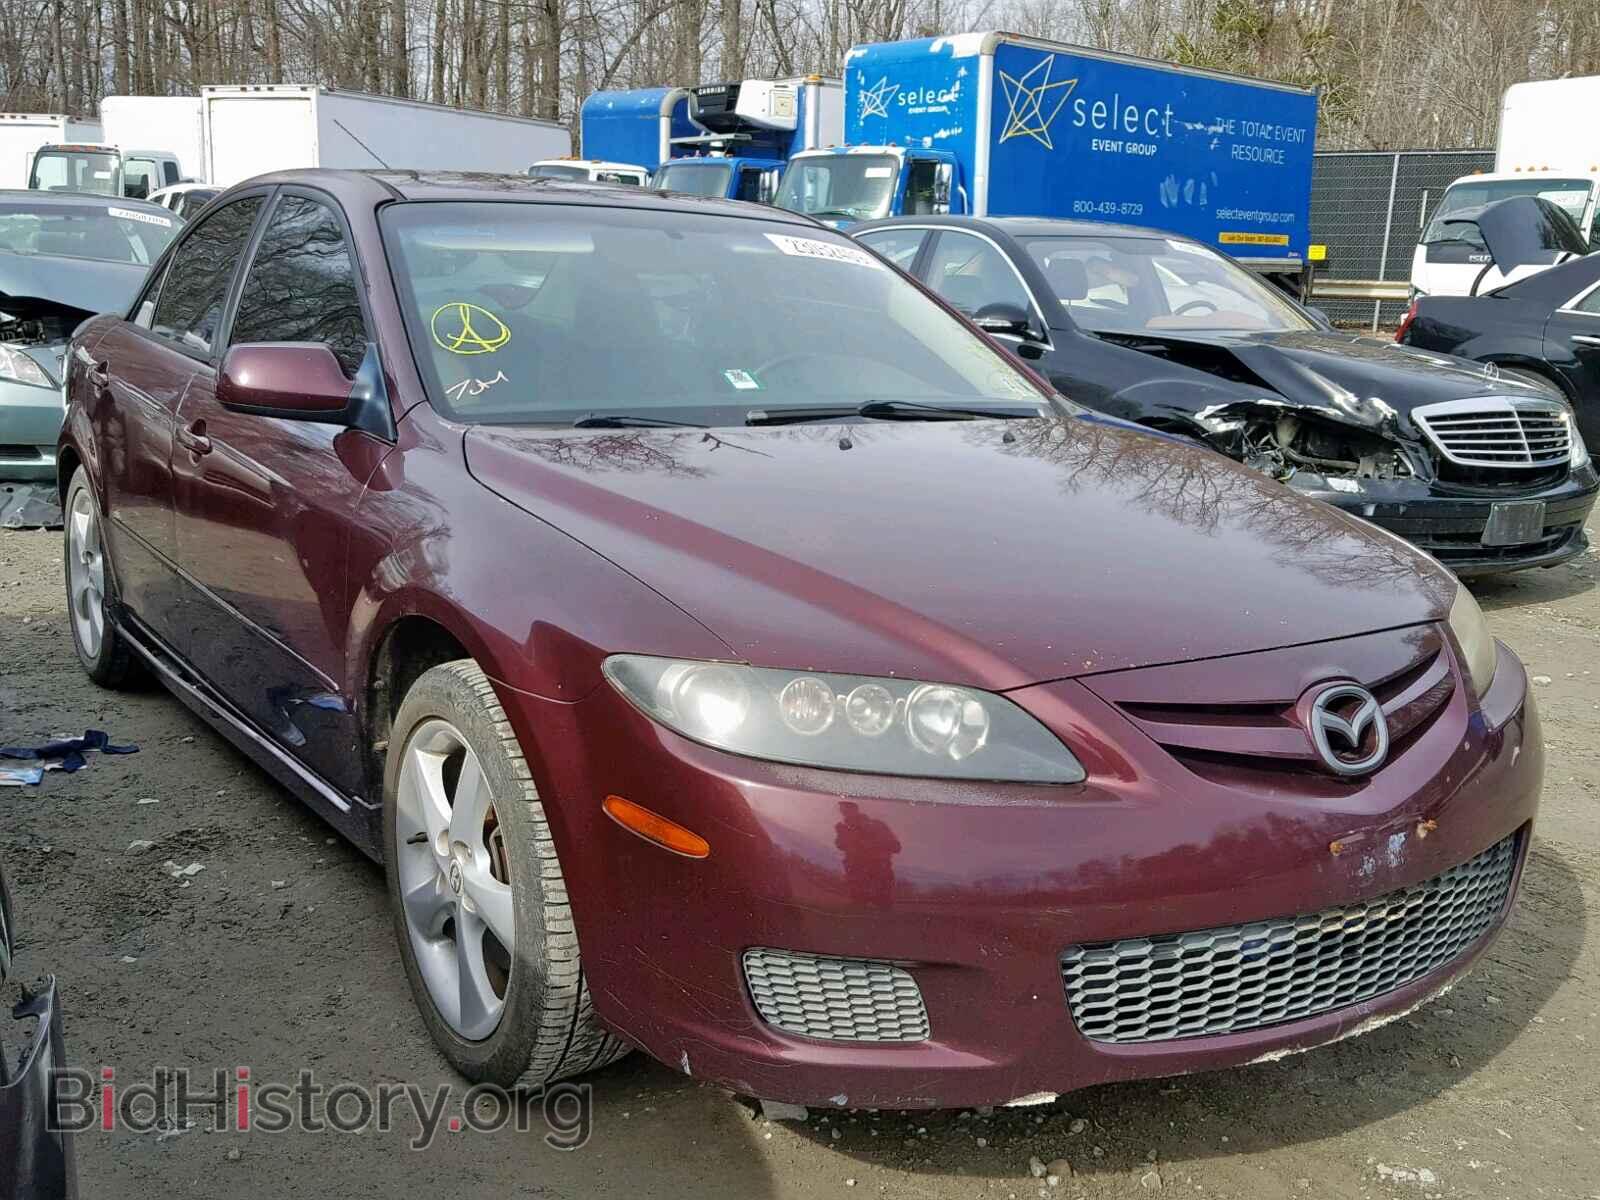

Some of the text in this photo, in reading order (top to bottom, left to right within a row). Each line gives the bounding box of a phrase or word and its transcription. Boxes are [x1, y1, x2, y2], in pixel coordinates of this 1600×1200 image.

[1072, 93, 1174, 137] select
[1216, 117, 1306, 144] THE TOTAL EVENT
[1091, 138, 1158, 156] EVENT GROUP
[1231, 144, 1286, 165] RESOURCE
[1072, 200, 1144, 216] 800-439-8729
[1215, 207, 1296, 224] selecteventgroup.com
